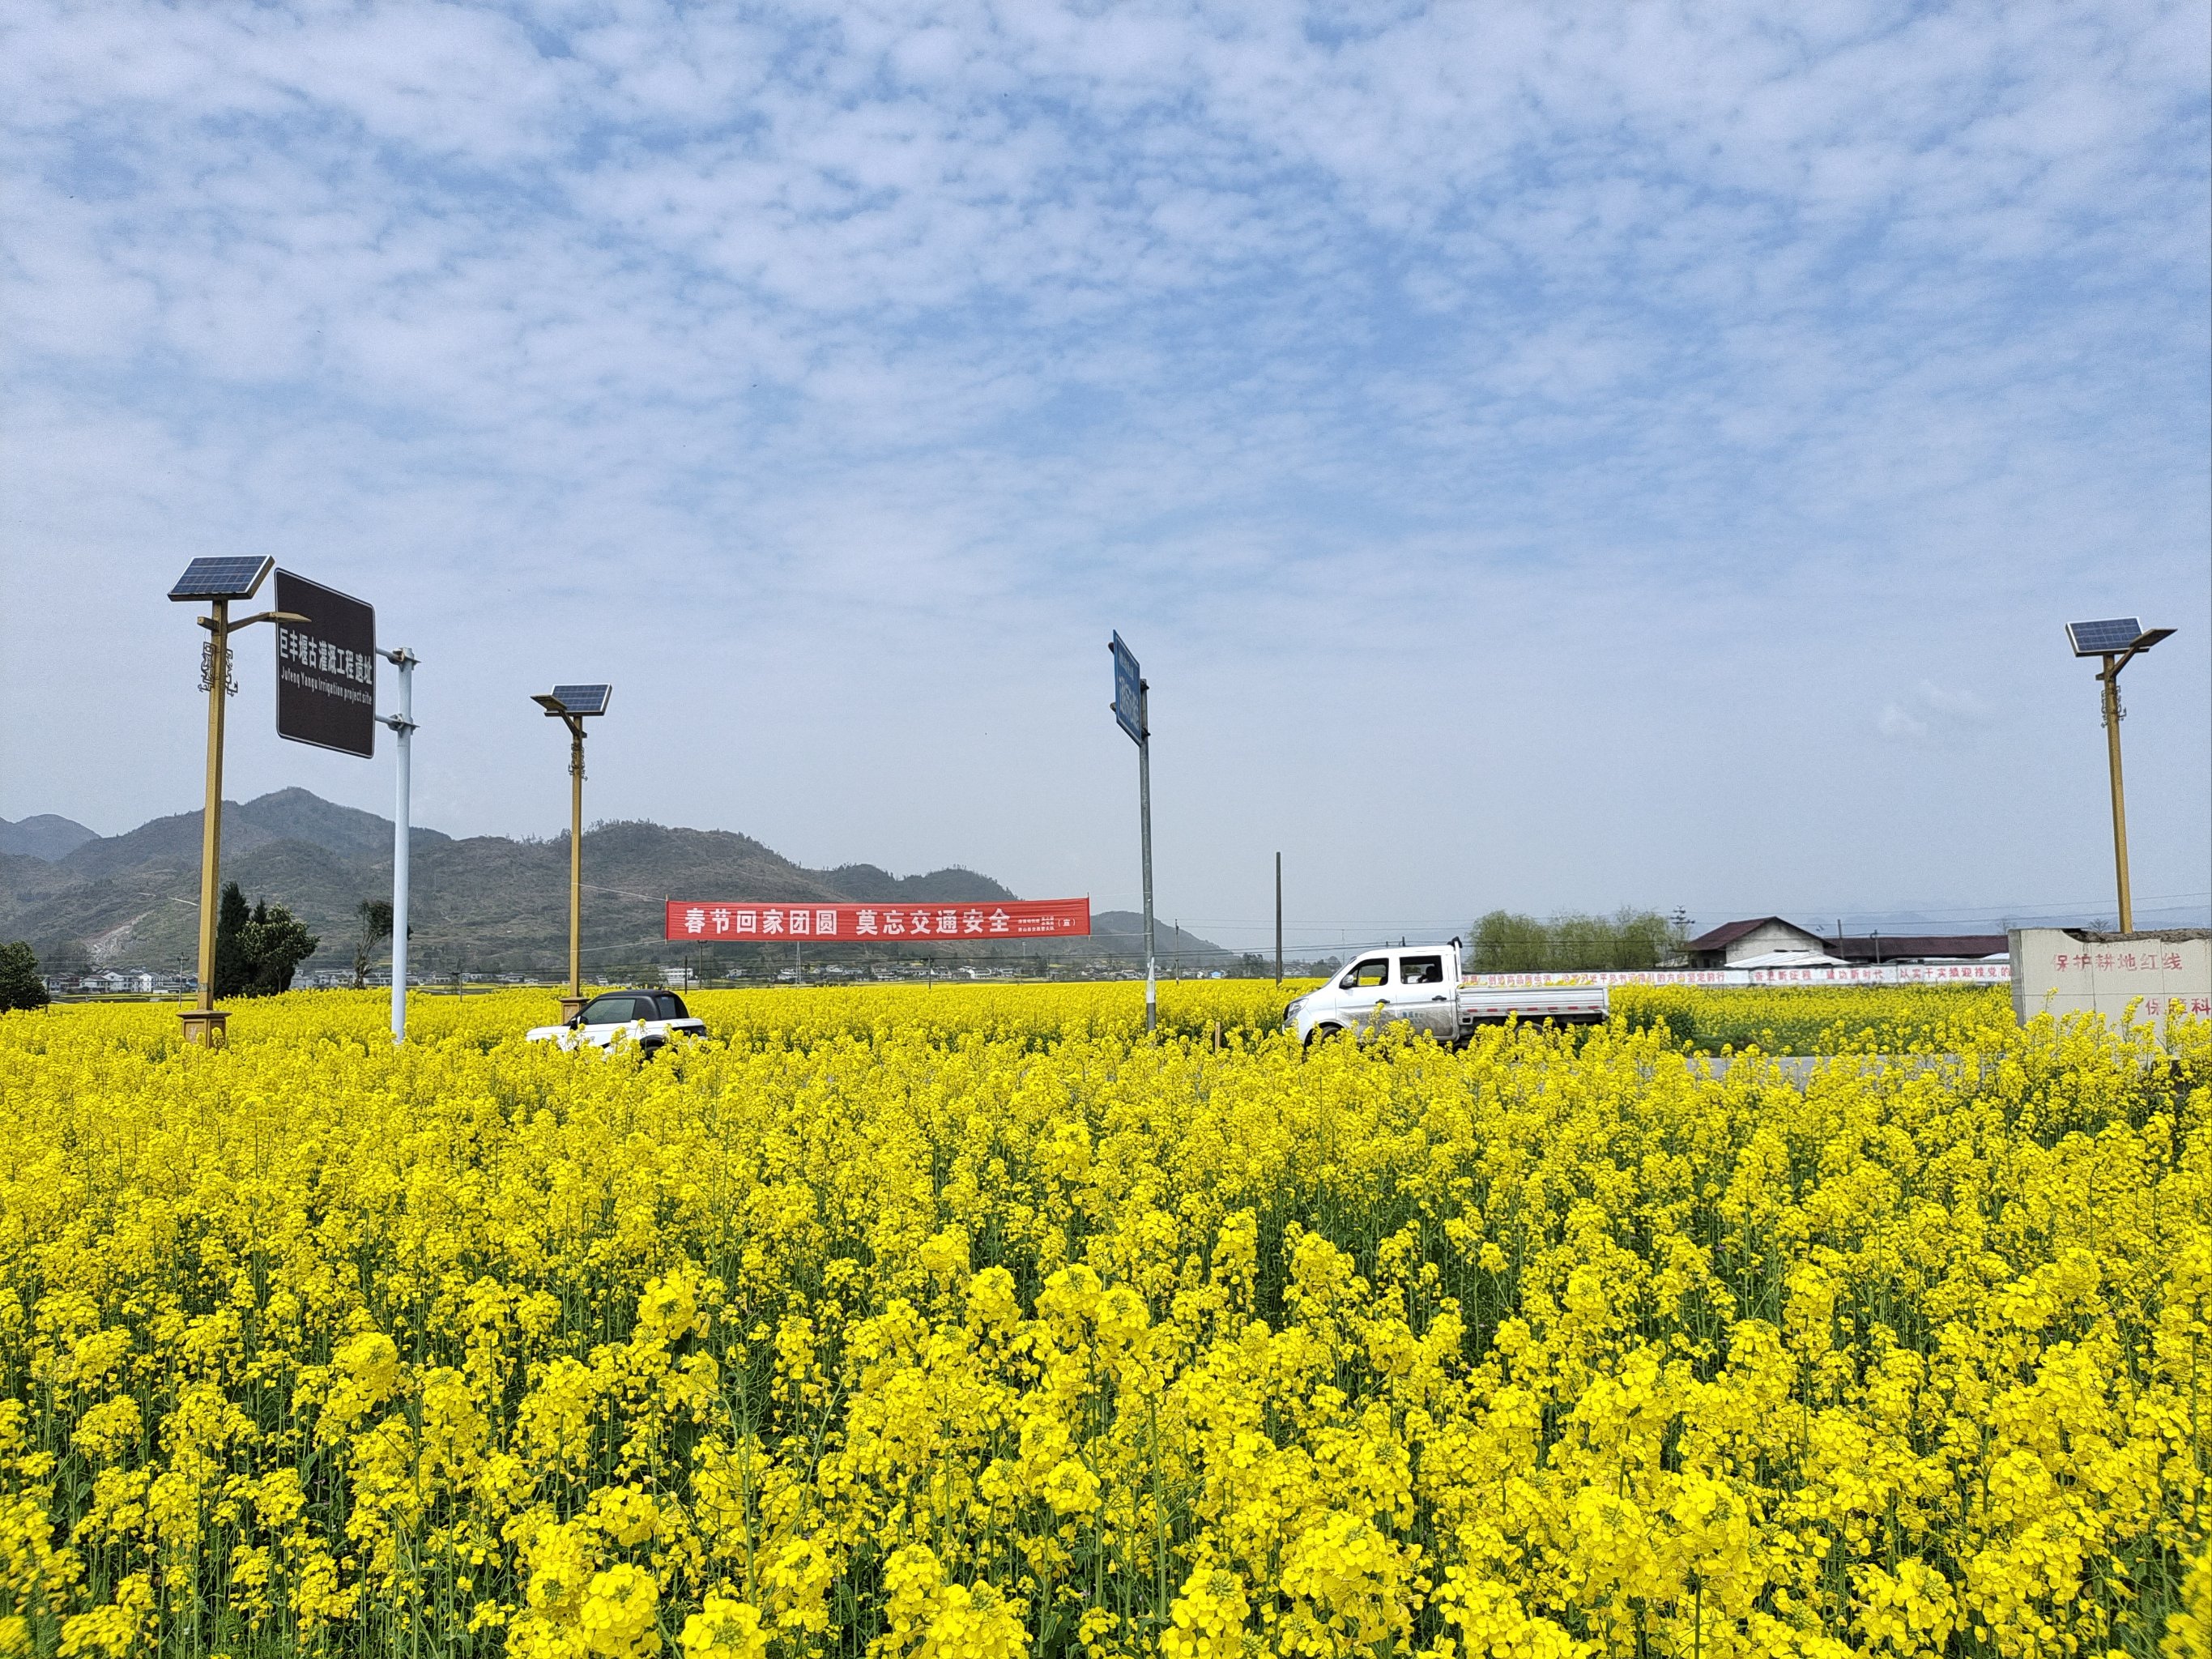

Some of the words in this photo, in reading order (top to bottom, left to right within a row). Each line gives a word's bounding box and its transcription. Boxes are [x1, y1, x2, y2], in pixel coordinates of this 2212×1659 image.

[281, 666, 300, 689] Jufeng
[318, 677, 343, 697] Irrigation
[344, 687, 361, 704] project
[362, 690, 372, 706] site
[684, 908, 837, 936] 春节回家团圆
[855, 908, 1010, 936] 莫忘交通安全
[2052, 953, 2183, 972] 保护耕地红线
